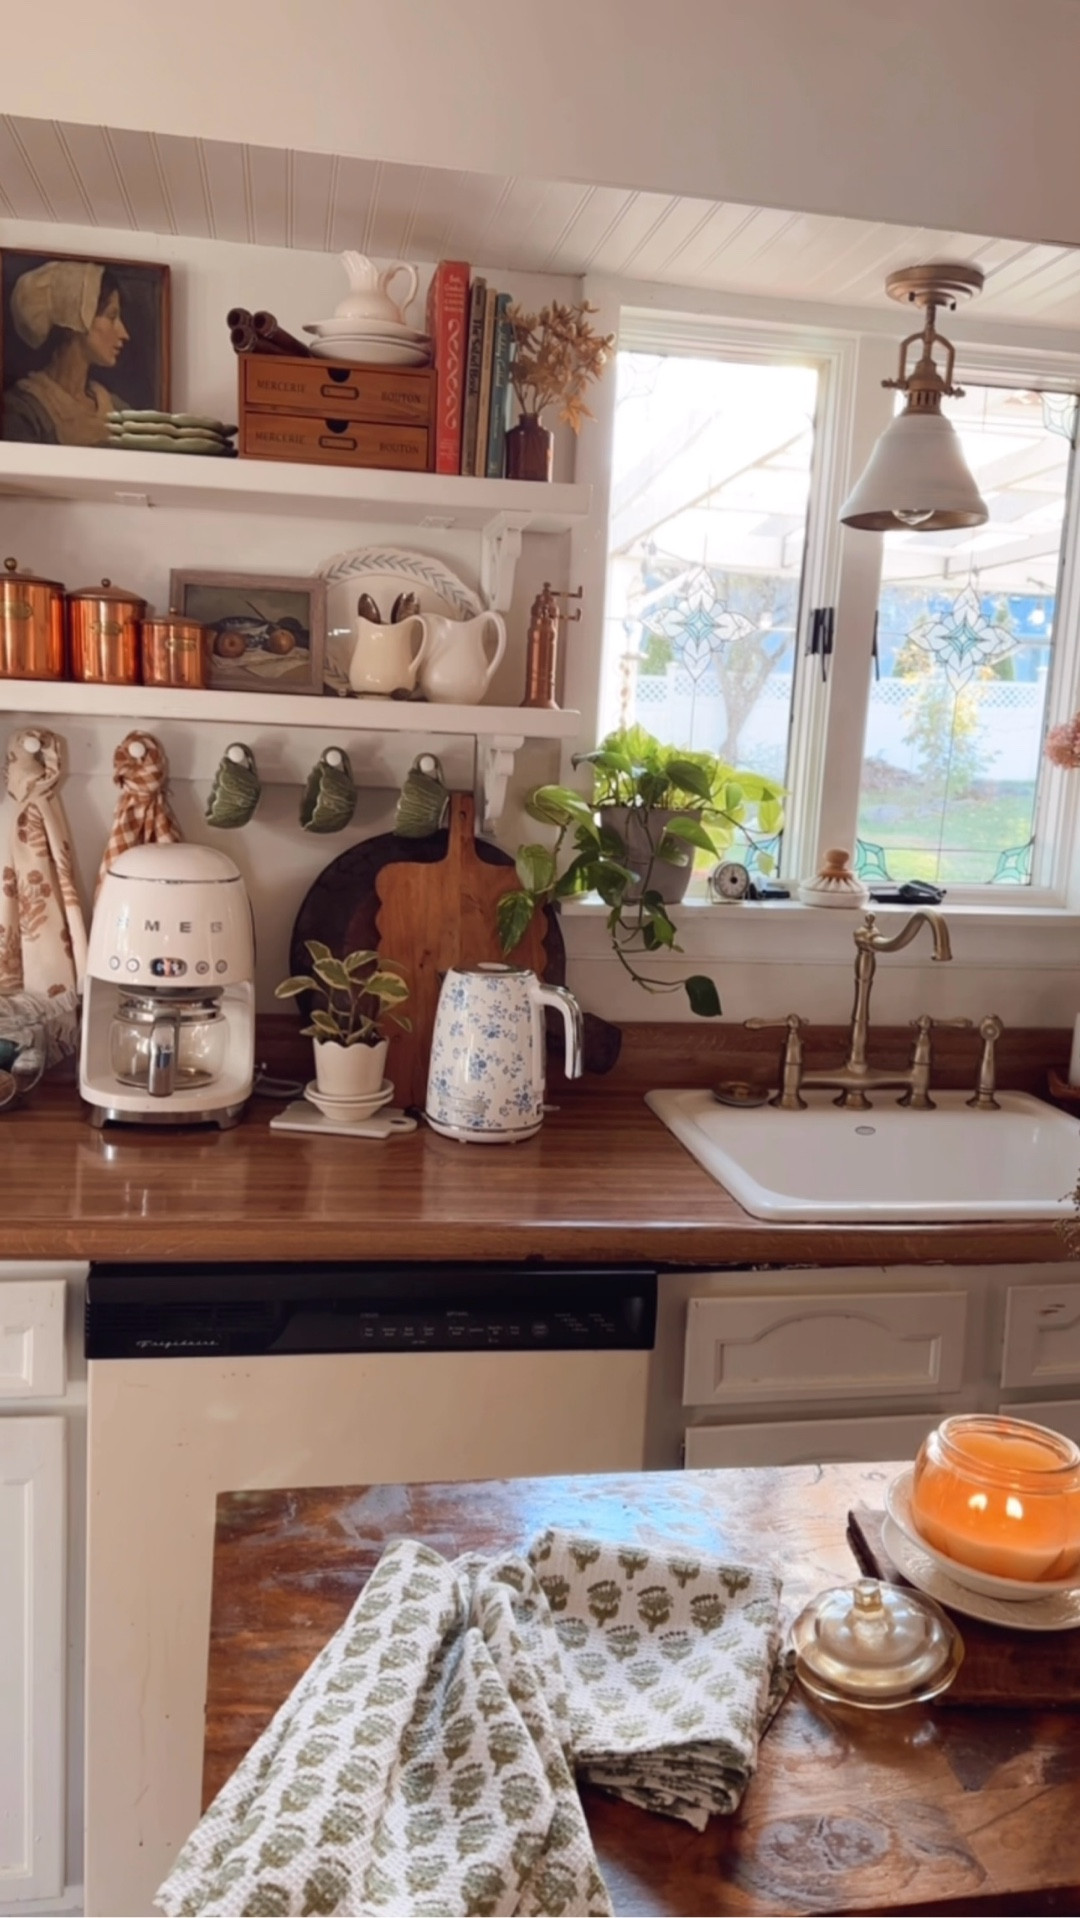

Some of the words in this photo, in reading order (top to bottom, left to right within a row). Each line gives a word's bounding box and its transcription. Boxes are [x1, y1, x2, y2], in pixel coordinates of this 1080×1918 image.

[256, 379, 307, 393] MERCERIE
[381, 391, 422, 404] BOUTON
[255, 431, 306, 445] MERCERIE
[379, 442, 420, 455] BOUTON
